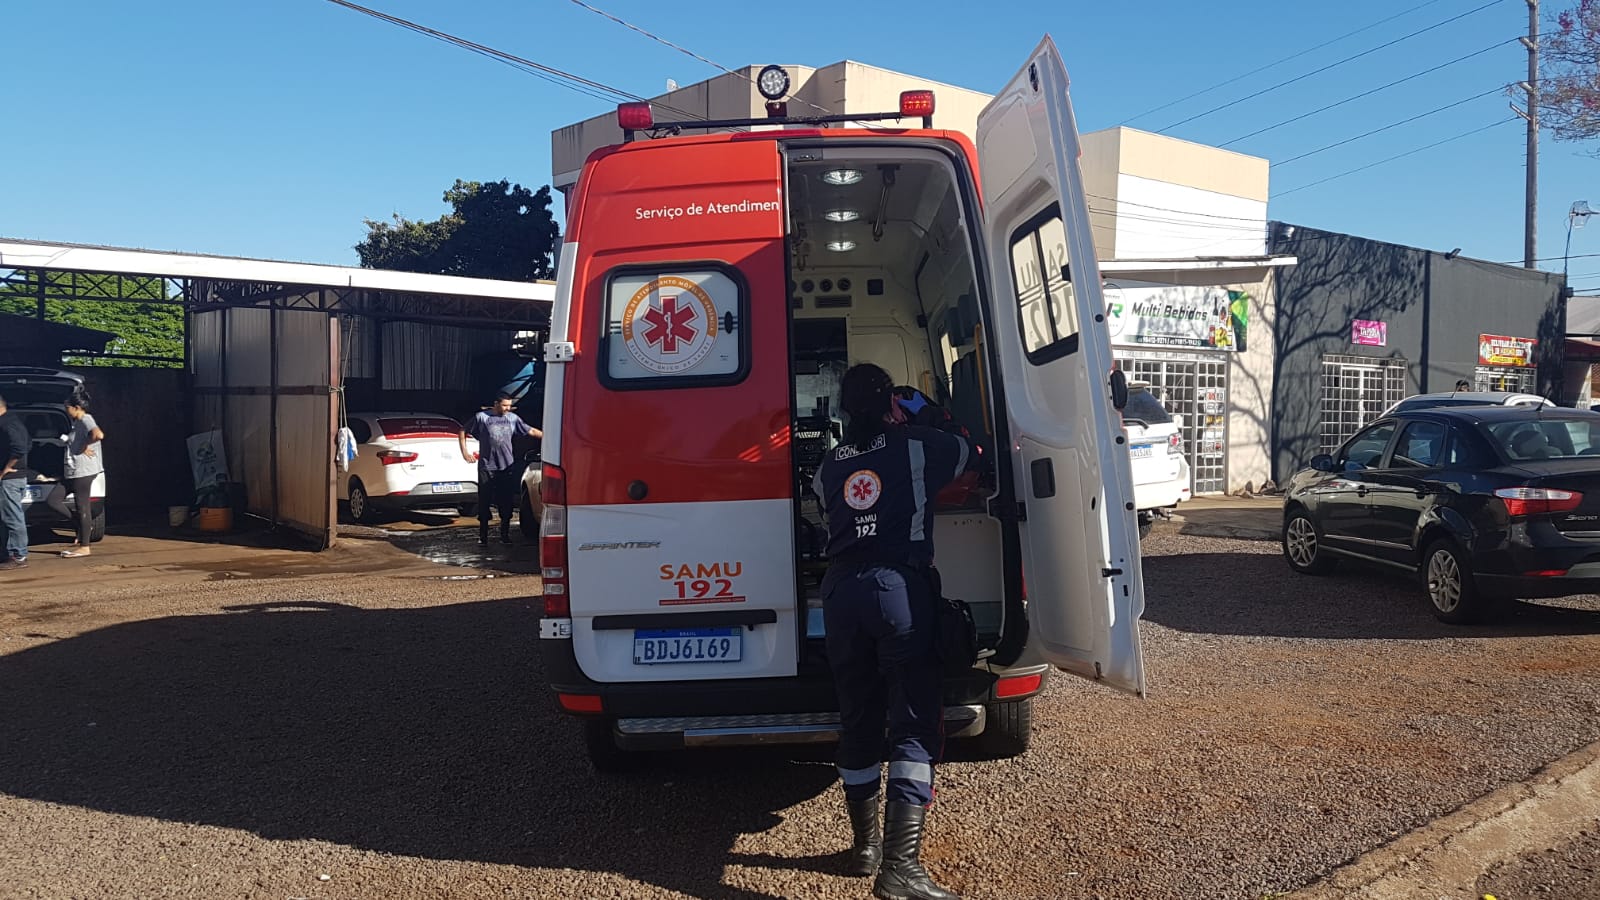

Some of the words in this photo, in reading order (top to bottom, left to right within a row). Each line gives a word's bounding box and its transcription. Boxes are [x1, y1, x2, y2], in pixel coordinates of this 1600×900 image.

[635, 206, 683, 220] Serviço
[686, 203, 703, 216] de
[707, 200, 780, 214] Atendimen
[1132, 302, 1161, 317] Multi
[1163, 304, 1209, 321] Bebidas
[838, 437, 883, 458] CONOR
[855, 513, 877, 524] SAMU
[855, 523, 877, 538] 192
[578, 541, 662, 551] SPRINTER
[659, 561, 743, 580] SAMU
[673, 578, 734, 598] 192
